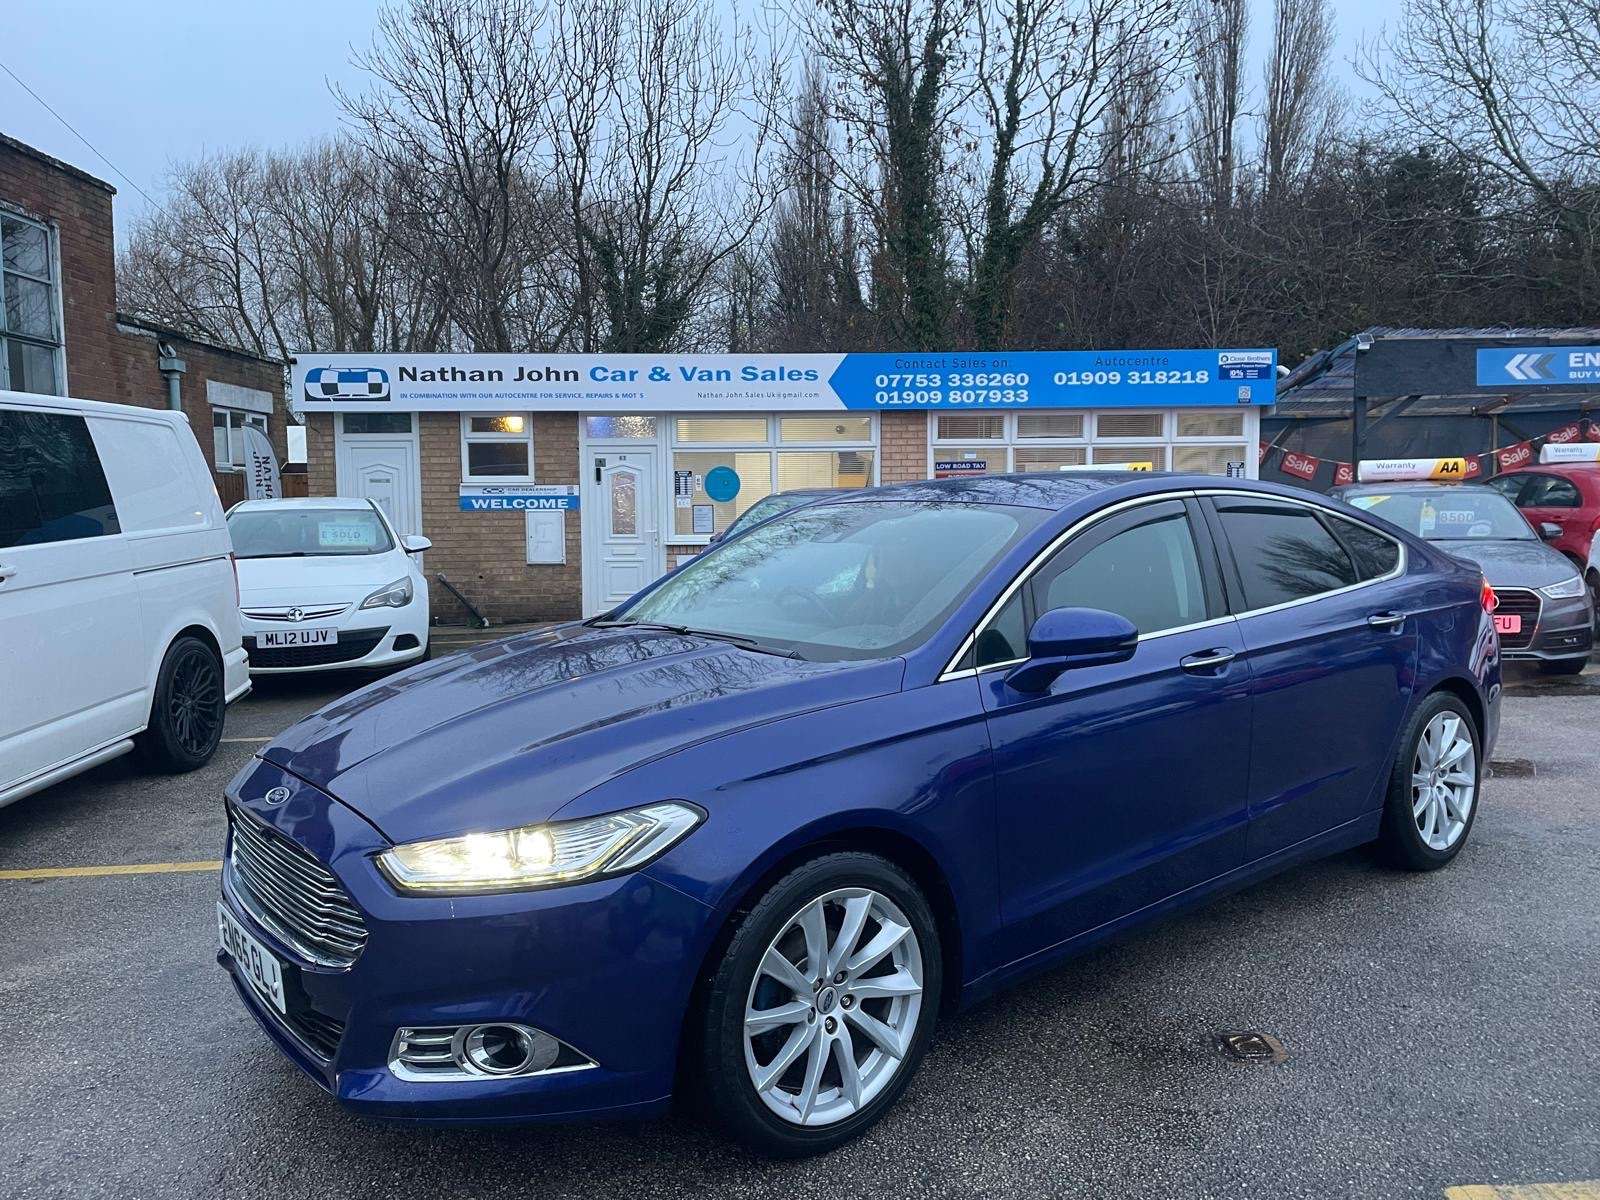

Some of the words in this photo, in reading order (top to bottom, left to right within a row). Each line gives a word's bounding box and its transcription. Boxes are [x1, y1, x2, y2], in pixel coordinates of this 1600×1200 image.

[895, 359, 946, 369] Contact
[952, 358, 986, 368] Sales
[992, 359, 1008, 367] on
[1095, 356, 1169, 366] Autocentre
[398, 366, 504, 382] Nathan
[513, 366, 579, 382] John
[589, 366, 639, 382] Car
[648, 366, 671, 382] &
[679, 366, 731, 382] Van
[740, 365, 819, 382] Sales
[875, 374, 942, 388] 07753
[948, 372, 1029, 387] 336260
[1054, 371, 1121, 385] 01909
[1127, 370, 1209, 385] 318218
[1569, 371, 1592, 379] BUY
[875, 390, 942, 404] 01909
[948, 389, 1029, 403] 807933
[1550, 426, 1578, 444] Sale
[1285, 454, 1315, 474] Sale
[1501, 448, 1530, 466] Sale
[253, 451, 264, 487] JOHN
[1376, 462, 1416, 471] Warranty
[1440, 461, 1459, 473] AA
[1466, 460, 1478, 472] le
[262, 456, 273, 499] NATHA
[1339, 467, 1353, 481] Sa
[471, 498, 569, 509] WELCOME
[265, 632, 297, 646] ML12
[301, 630, 328, 644] UJV
[221, 911, 251, 970] EN65
[250, 944, 278, 1000] GLJ
